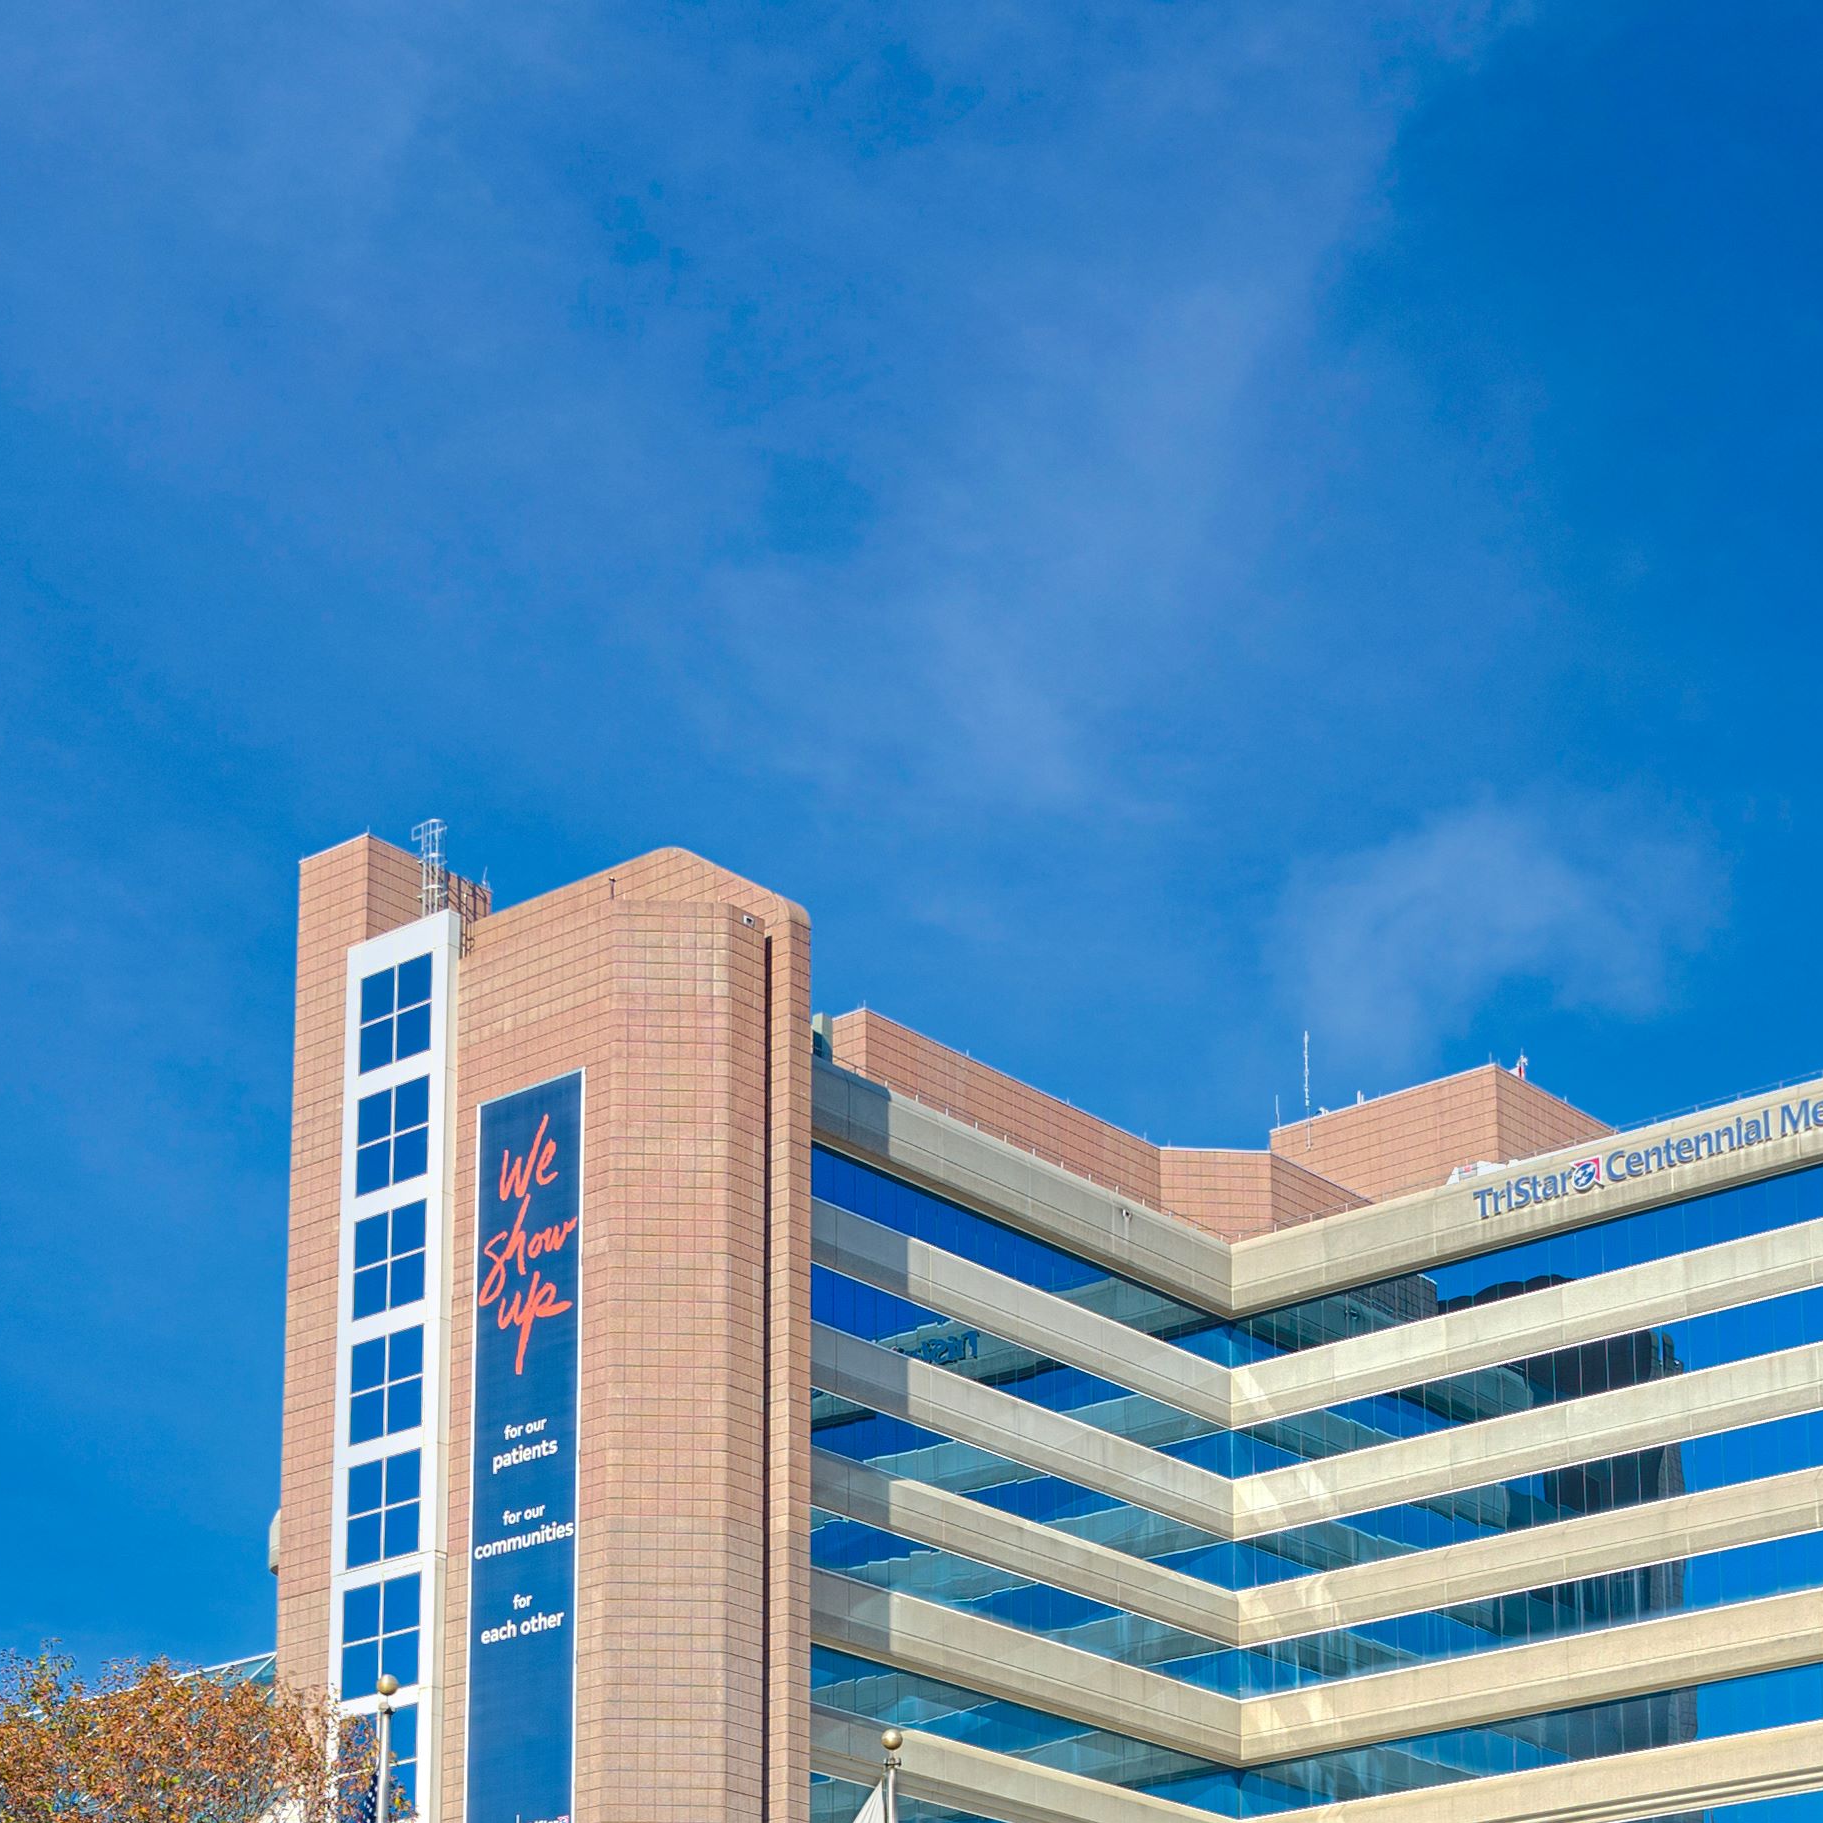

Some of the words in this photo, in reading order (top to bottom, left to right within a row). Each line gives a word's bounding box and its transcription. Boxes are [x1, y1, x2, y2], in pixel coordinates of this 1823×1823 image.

[499, 1113, 558, 1201] We
[1472, 1168, 1573, 1219] TriStar
[1606, 1109, 1772, 1181] Centennial
[497, 1271, 573, 1375] up
[504, 1424, 523, 1440] for
[525, 1418, 547, 1434] our
[492, 1438, 558, 1474] patients
[502, 1510, 522, 1526] for
[524, 1504, 545, 1520] our
[474, 1521, 574, 1560] communities
[513, 1594, 532, 1610] for
[480, 1620, 517, 1645] each
[520, 1611, 564, 1636] other
